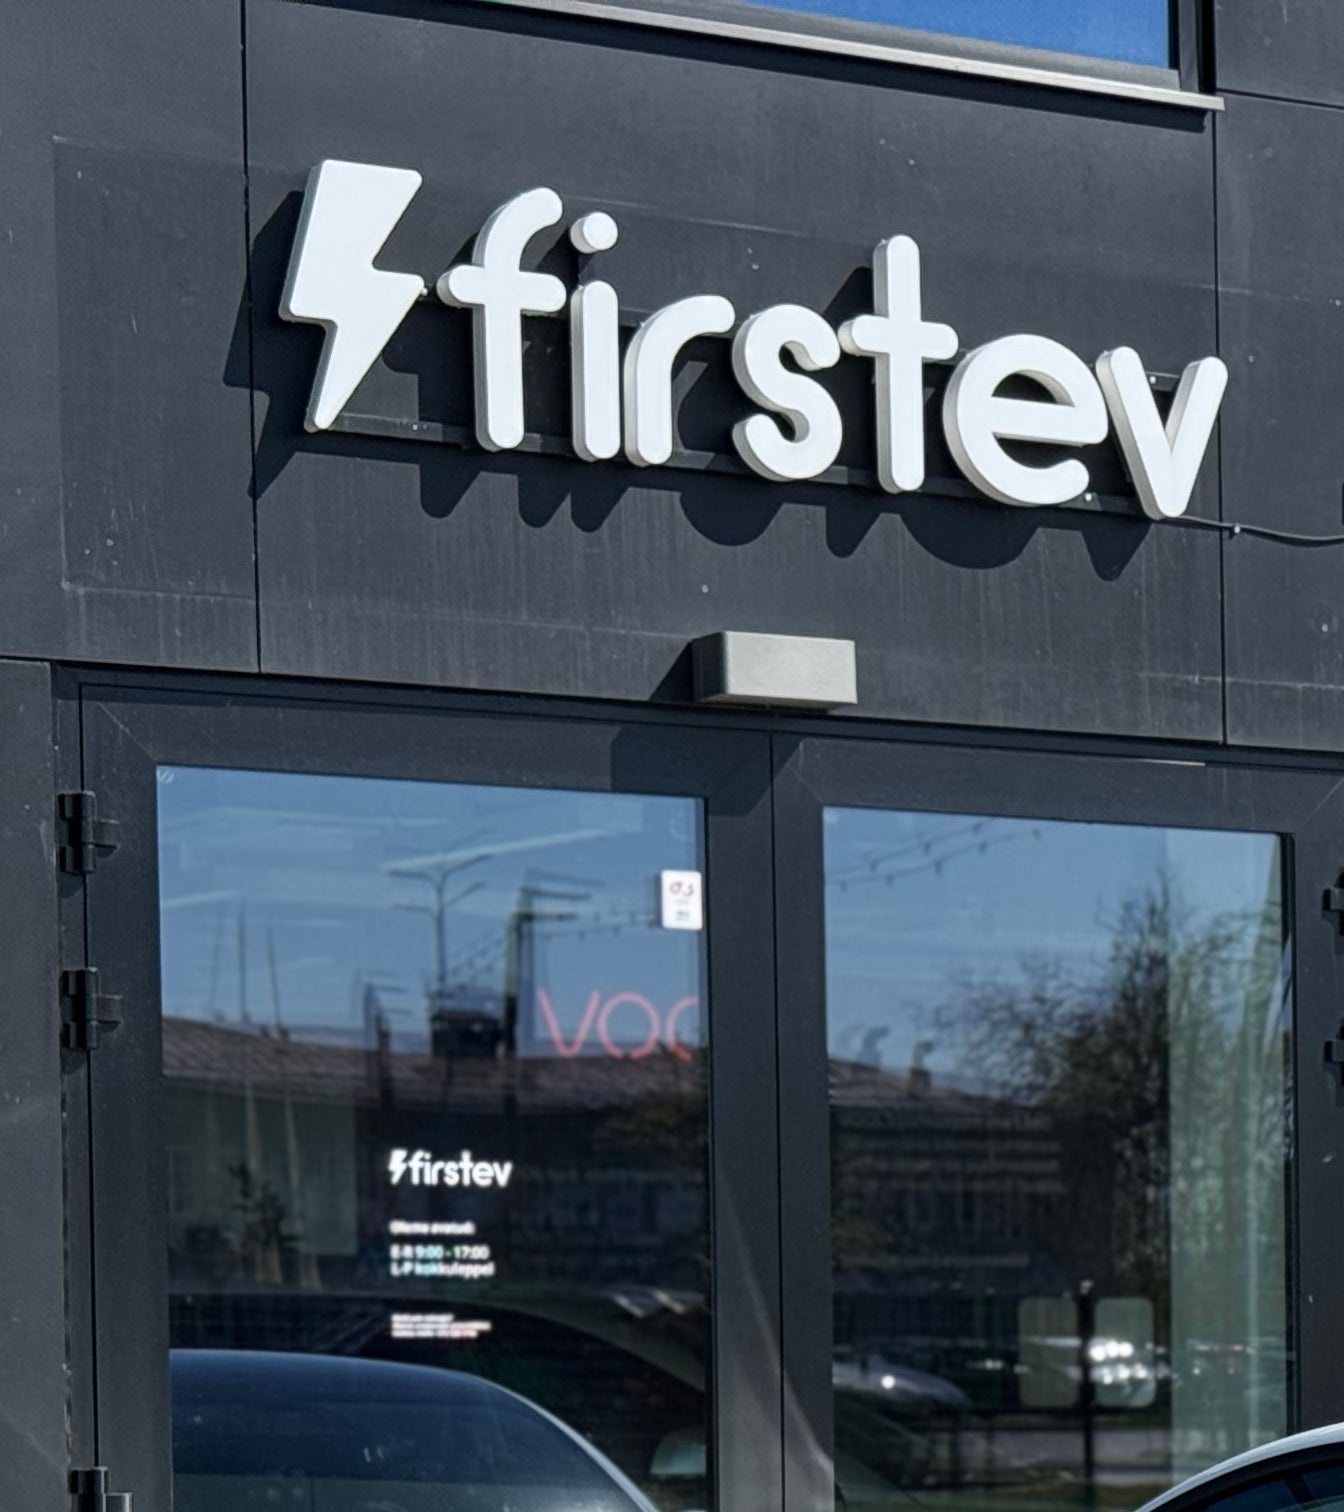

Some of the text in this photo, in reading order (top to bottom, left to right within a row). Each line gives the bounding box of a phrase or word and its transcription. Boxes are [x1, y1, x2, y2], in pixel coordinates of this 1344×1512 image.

[436, 187, 1229, 520] firstev
[408, 1149, 513, 1188] firstev
[453, 1244, 490, 1260] 17:00
